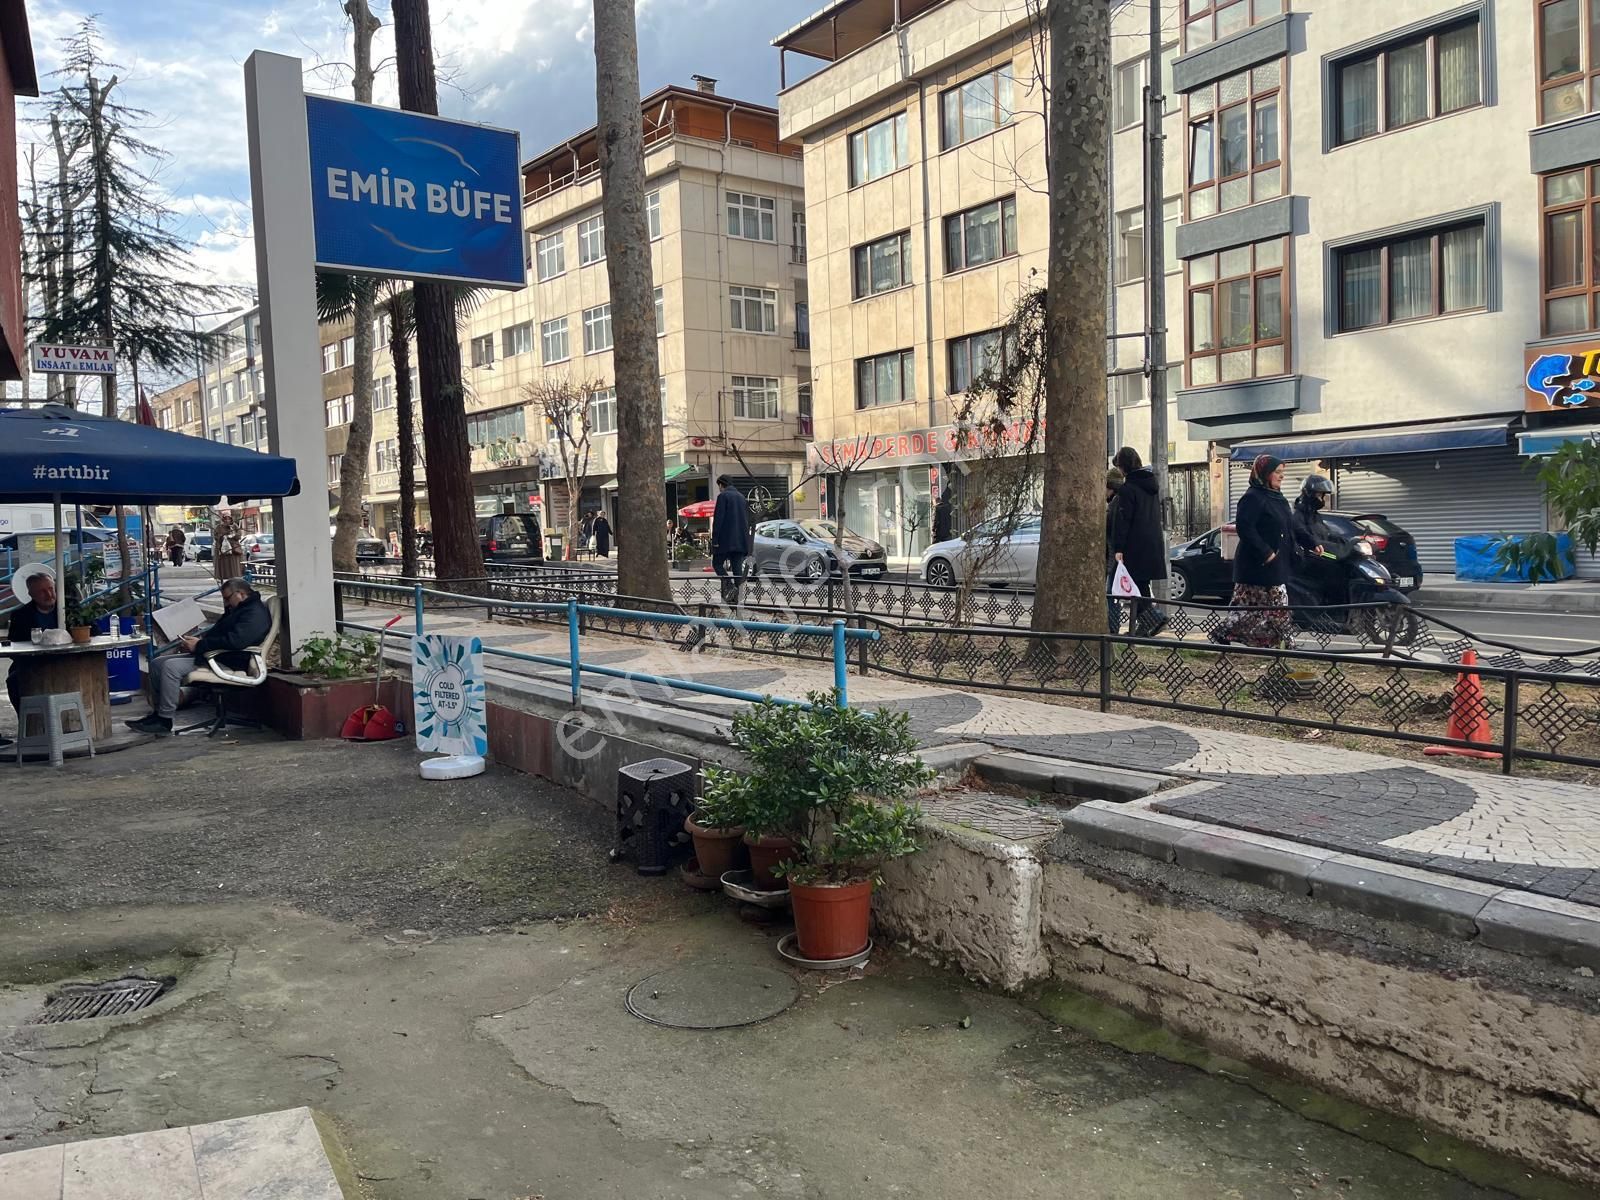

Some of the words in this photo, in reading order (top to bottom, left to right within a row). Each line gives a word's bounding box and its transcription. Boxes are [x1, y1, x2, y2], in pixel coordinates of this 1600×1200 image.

[327, 167, 416, 210] EMİR
[426, 180, 512, 223] BÜFE
[41, 347, 109, 360] YUVAM
[80, 362, 114, 372] EMLAK
[821, 440, 869, 465] SEMA
[872, 431, 938, 458] PERDE
[32, 464, 110, 481] #artıbir
[106, 648, 133, 659] BÜFE
[439, 681, 455, 690] COLD
[434, 690, 460, 700] FILTERED
